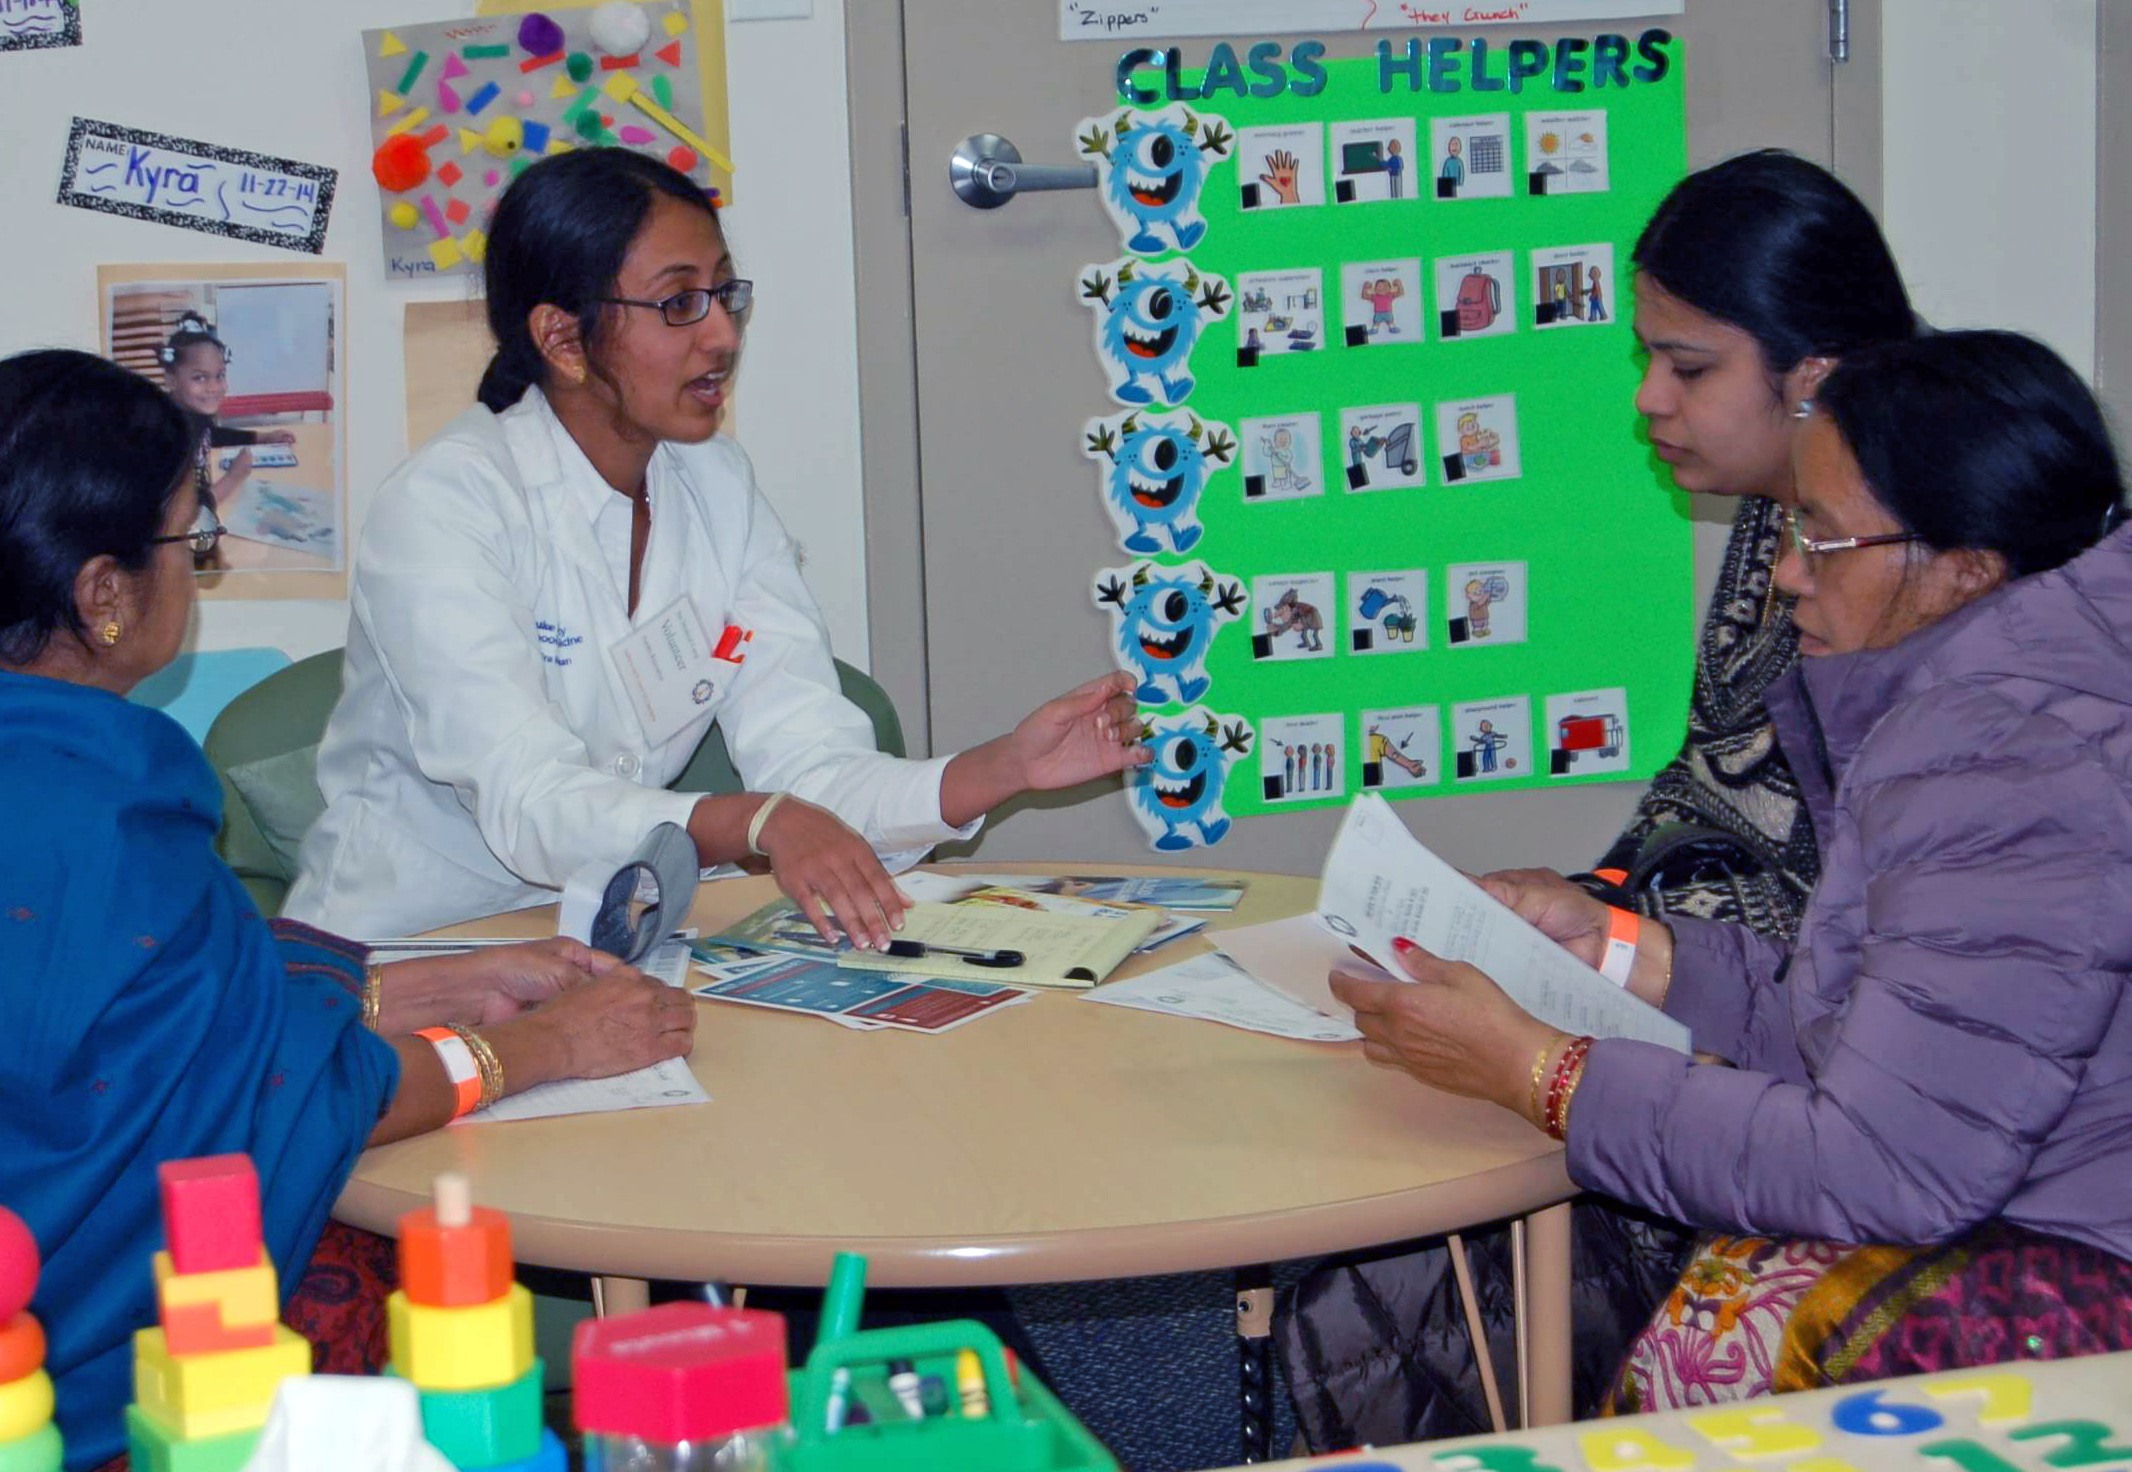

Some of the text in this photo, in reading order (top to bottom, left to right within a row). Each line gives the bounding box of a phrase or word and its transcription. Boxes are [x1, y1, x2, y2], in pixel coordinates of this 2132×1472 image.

[1116, 28, 1672, 103] CLASS HELPERS
[125, 145, 199, 203] Kyra
[240, 173, 315, 203] 11-22-14
[391, 256, 436, 279] Kyra
[1830, 1388, 1946, 1437] 6
[1917, 1372, 2034, 1424] 7
